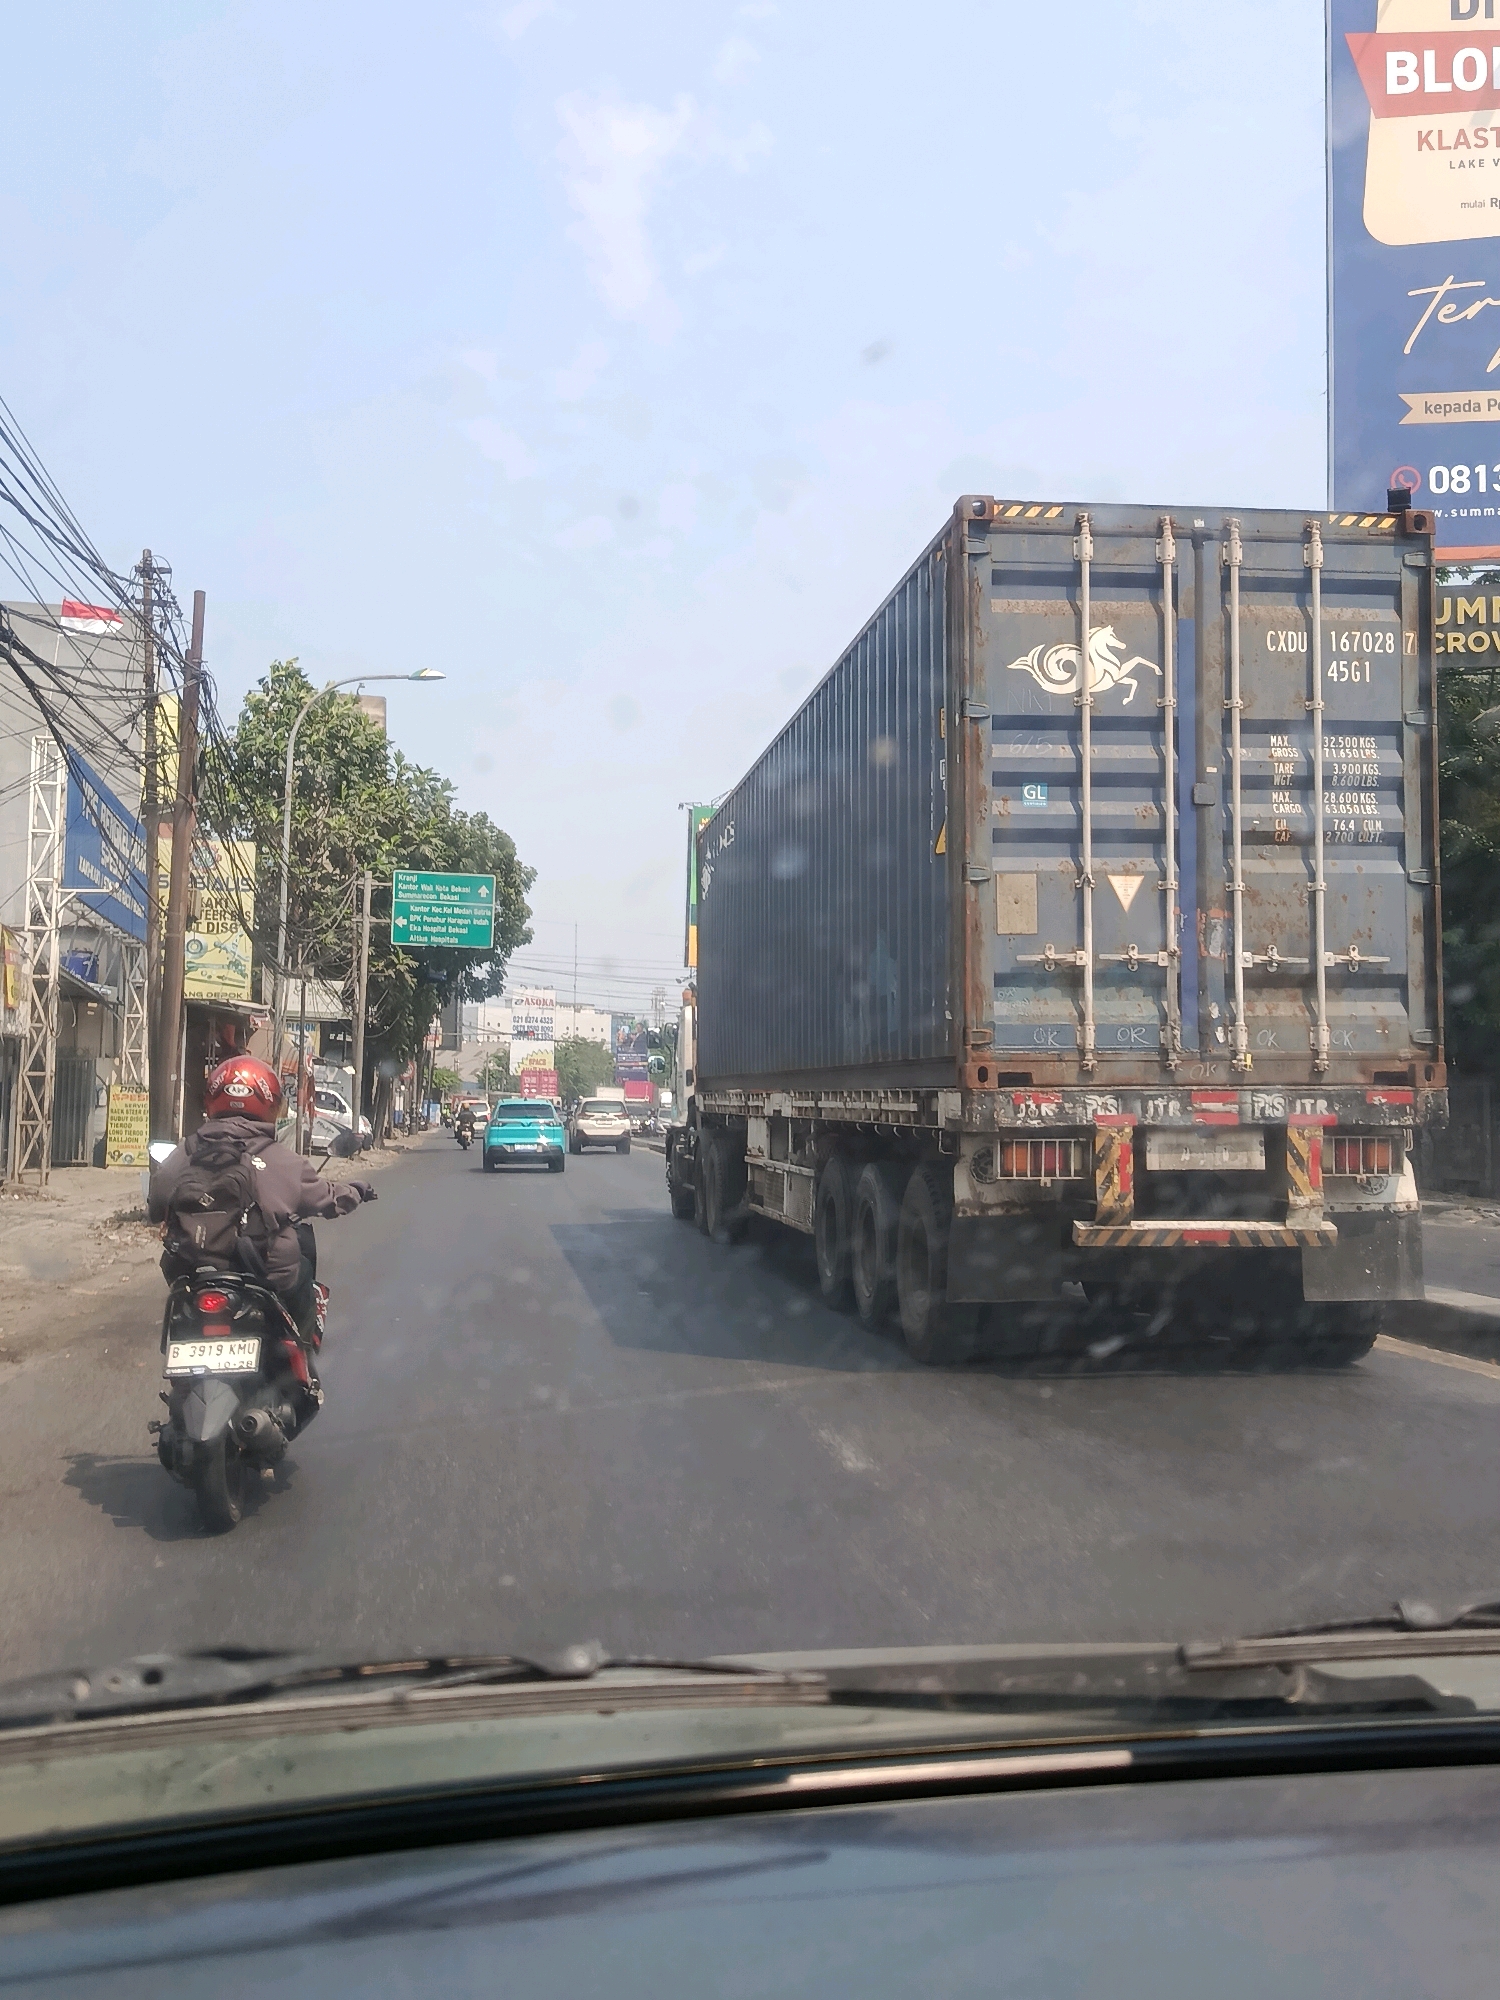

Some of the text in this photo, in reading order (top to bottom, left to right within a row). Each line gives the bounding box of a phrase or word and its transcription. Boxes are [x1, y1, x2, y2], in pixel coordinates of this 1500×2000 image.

[1386, 46, 1500, 95] BLO
[1449, 159, 1485, 169] LAKE
[1460, 199, 1486, 209] mulai
[1424, 399, 1482, 417] kepada
[1266, 630, 1415, 654] CXDU 167028 7
[1327, 660, 1371, 682] 45G1
[1270, 735, 1378, 749] MAX. 32.500 KGS.
[1271, 748, 1299, 758] GROSS
[1273, 763, 1381, 775] TARE 3.900 KGS.
[1273, 775, 1292, 786] WGT.
[1331, 776, 1360, 787] 8.600
[1023, 784, 1047, 800] GL
[1272, 792, 1379, 804] MAX. 28.600 KGS.
[1273, 804, 1302, 814] CARGO
[1325, 804, 1360, 814] 63.050
[398, 874, 418, 883] Kranji
[398, 883, 419, 891] Kantor
[450, 885, 471, 893] Bekasi
[398, 891, 460, 901] Summarecon Bekasi
[410, 905, 430, 913] Kantor
[453, 907, 473, 915] Medan
[409, 914, 422, 922] BPK
[473, 917, 490, 926] Indah
[409, 924, 468, 934] Eka Hospital Bekasi
[524, 997, 555, 1007] ASOKA
[1256, 1029, 1281, 1048] OK
[1332, 1029, 1354, 1051] OK
[1294, 1098, 1330, 1116] JTR
[172, 1342, 256, 1358] B 3919 KMU
